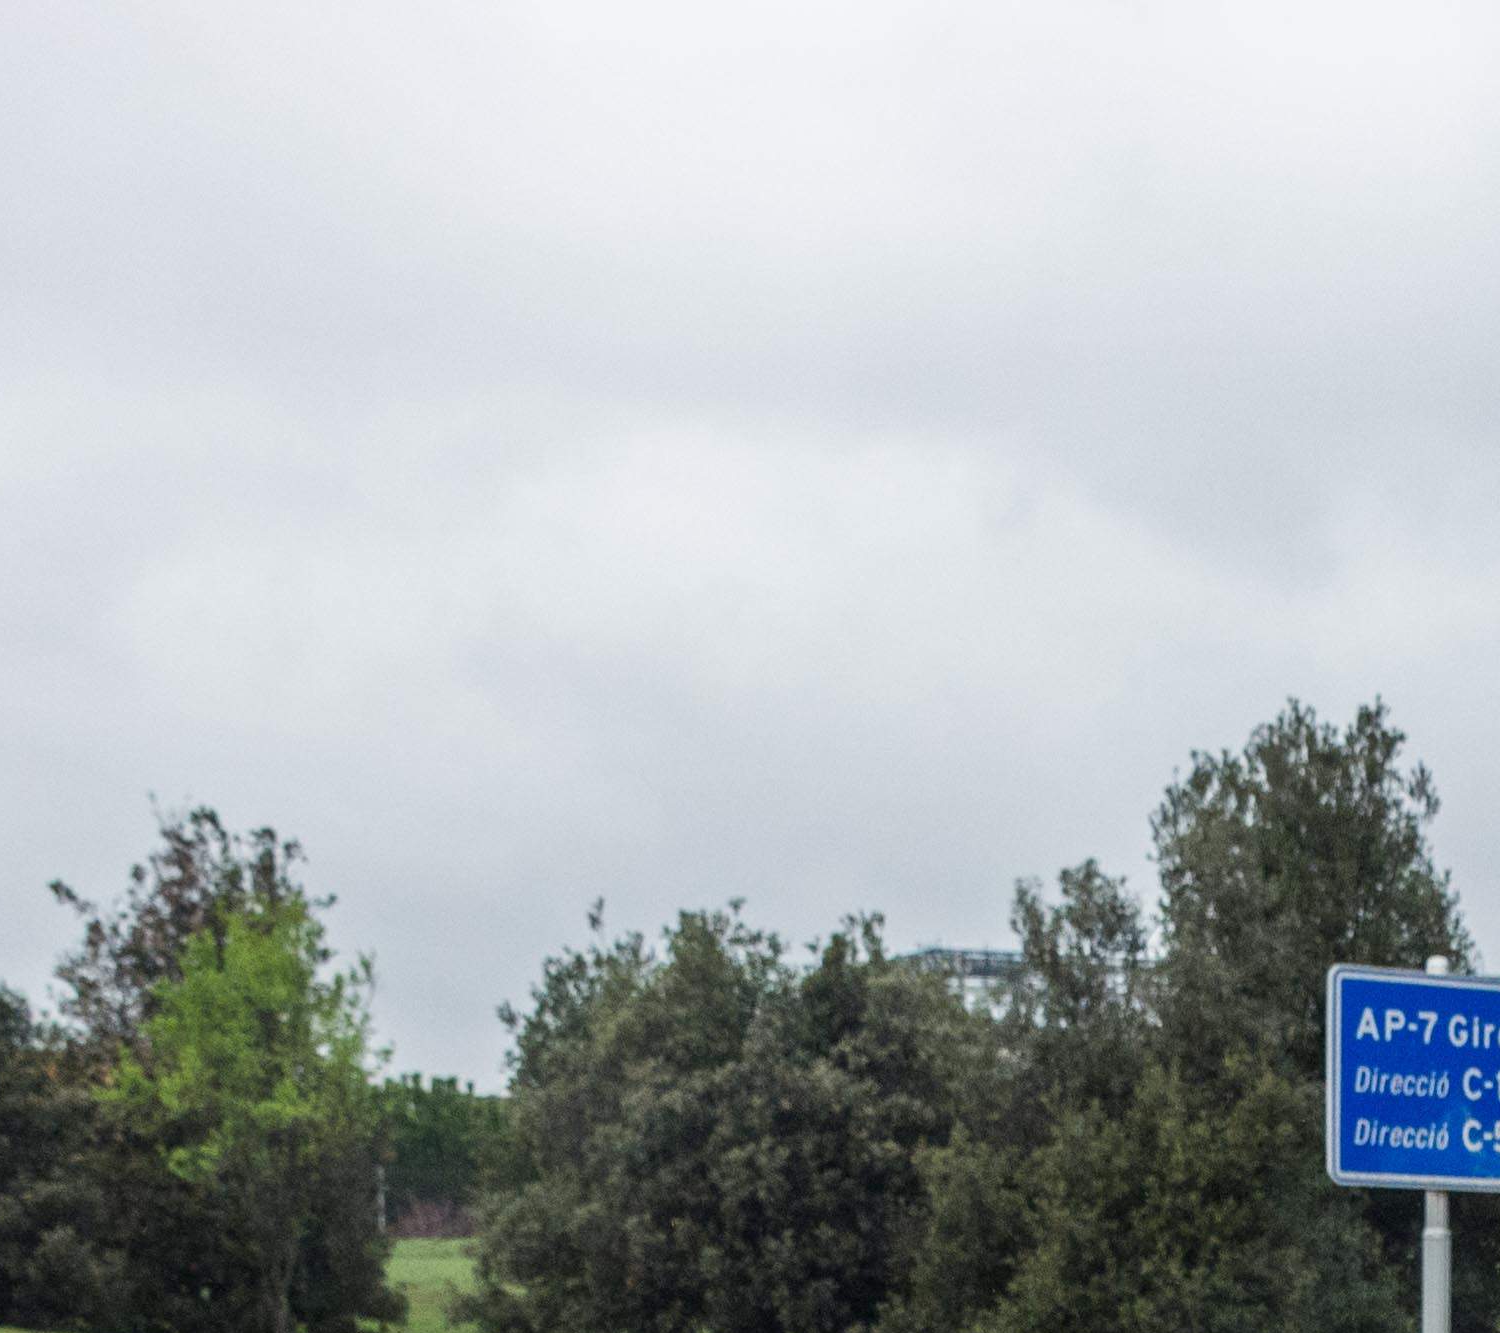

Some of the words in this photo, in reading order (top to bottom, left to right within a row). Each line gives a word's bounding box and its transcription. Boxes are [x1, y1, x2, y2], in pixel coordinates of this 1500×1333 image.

[1356, 1006, 1438, 1045] AP-7
[1354, 1065, 1450, 1098] Direcció
[1354, 1117, 1450, 1151] Direcció
